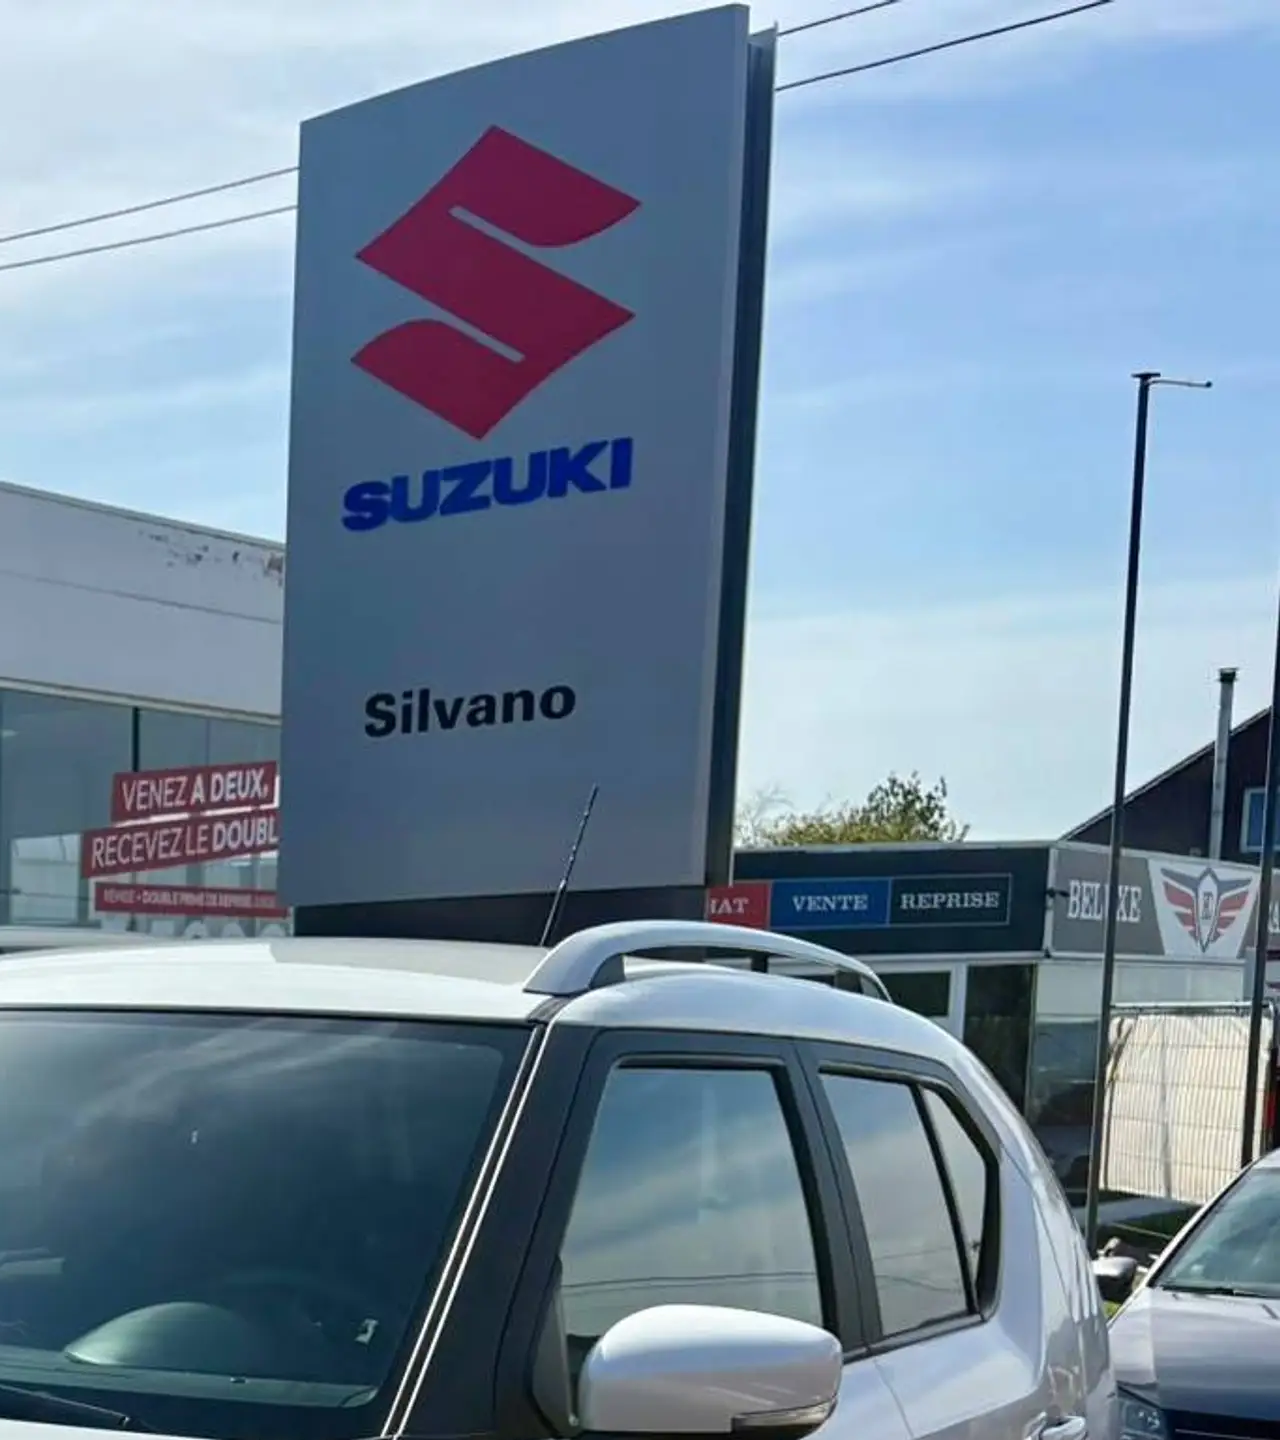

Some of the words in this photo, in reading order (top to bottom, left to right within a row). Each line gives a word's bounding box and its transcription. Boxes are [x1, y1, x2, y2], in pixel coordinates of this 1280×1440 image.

[341, 437, 633, 531] SUZUKI
[364, 684, 577, 738] Silvano
[122, 775, 188, 812] VENEZ
[190, 774, 205, 804] A
[211, 768, 269, 801] DEUX,
[91, 826, 184, 869] RECEVEZ
[186, 823, 209, 855] LE
[792, 894, 869, 912] VENTE
[900, 891, 1001, 910] REPRISE
